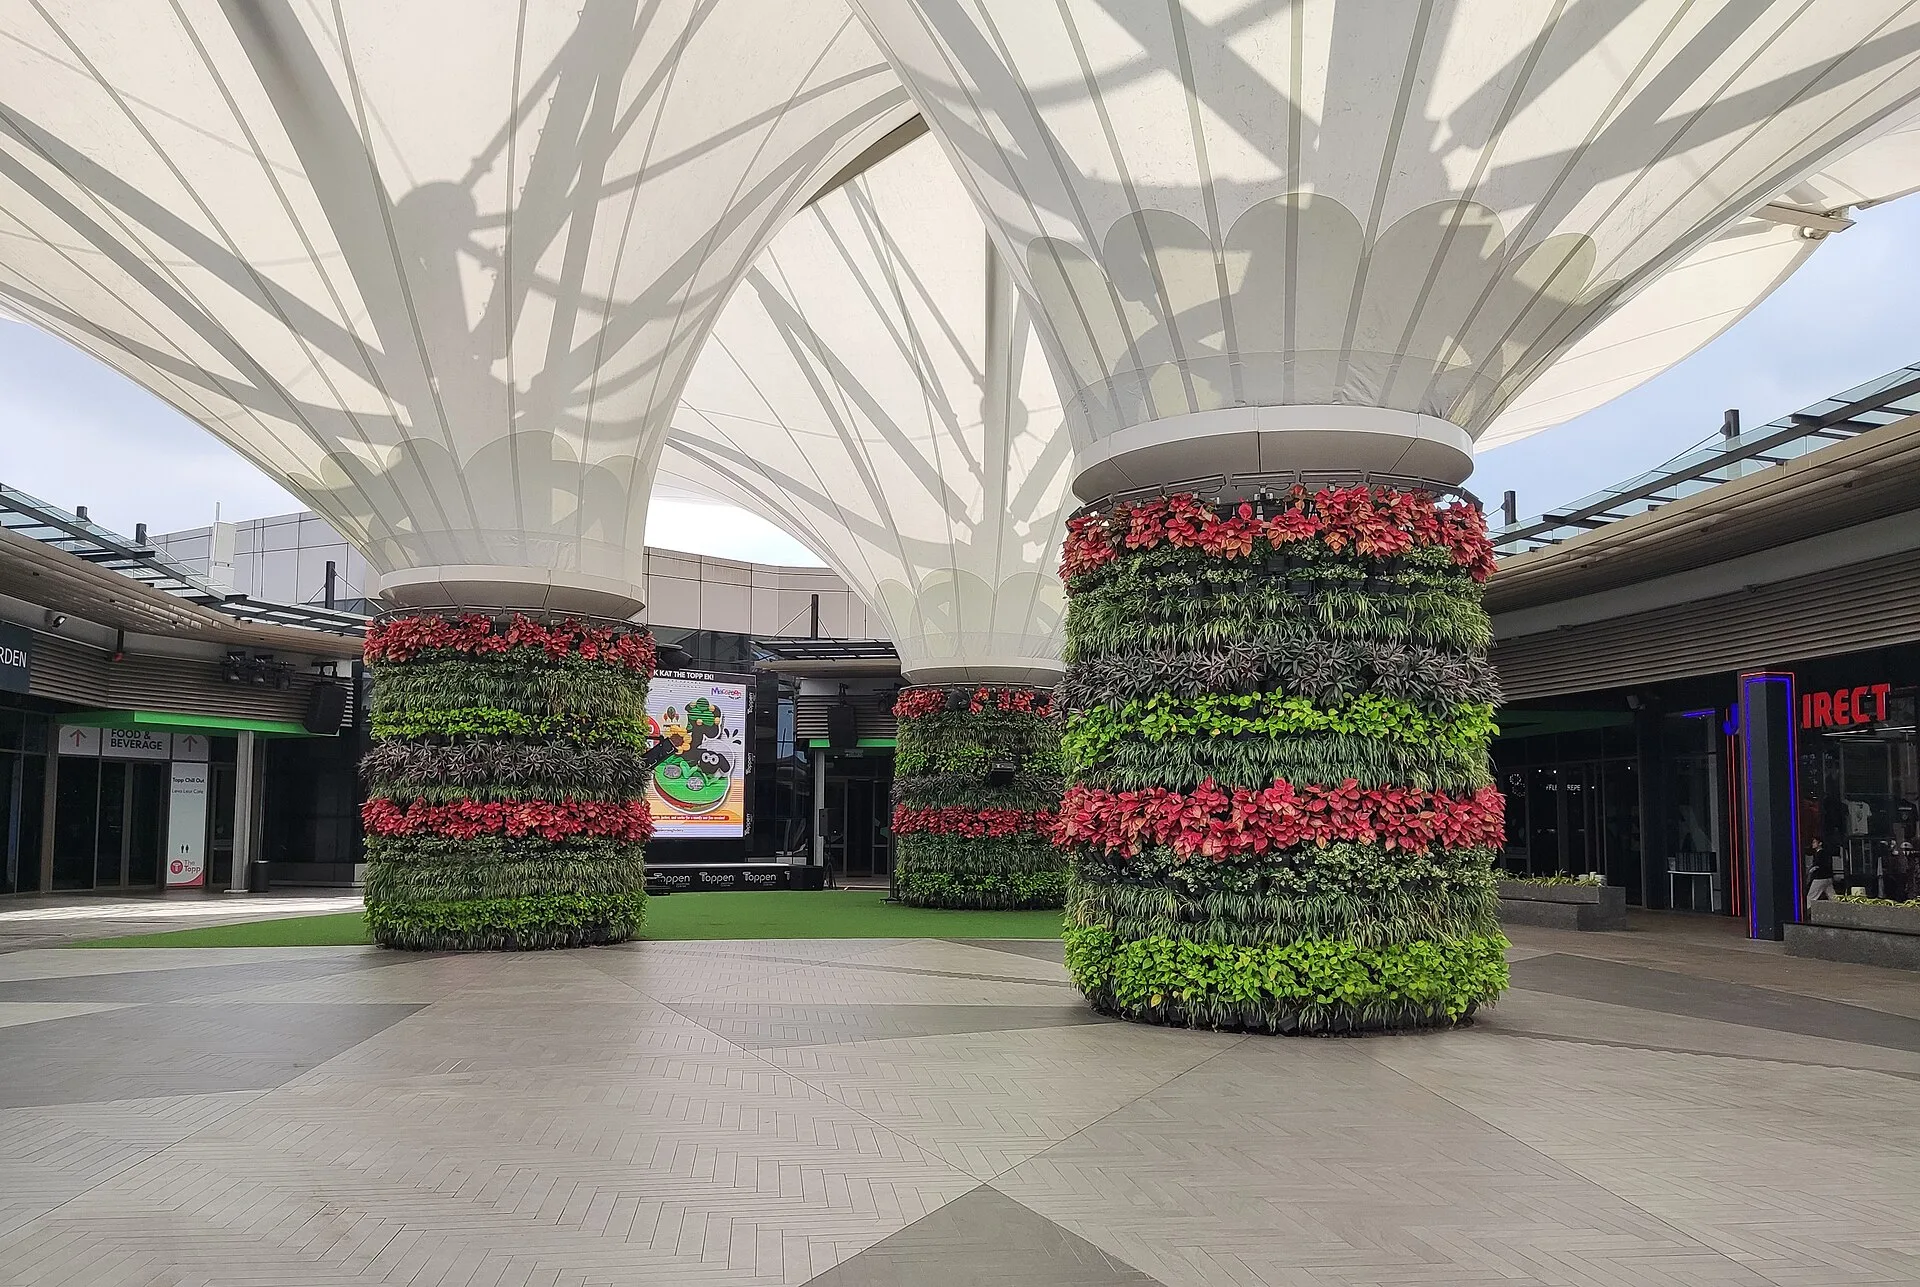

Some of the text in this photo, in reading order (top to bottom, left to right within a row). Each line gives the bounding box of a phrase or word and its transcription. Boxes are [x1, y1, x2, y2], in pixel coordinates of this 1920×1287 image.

[660, 670, 673, 678] KAT
[673, 671, 686, 679] THE
[687, 672, 704, 680] TOPP
[704, 673, 715, 681] EK!
[746, 692, 754, 715] Toppen
[1801, 683, 1891, 729] IRECT
[111, 728, 151, 740] FOOD &
[110, 738, 163, 751] BEVERAGE
[745, 752, 753, 775] Toppen
[744, 813, 752, 836] Toppen
[184, 865, 201, 874] Topp
[699, 871, 735, 884] Toppen
[742, 871, 777, 884] Toppen
